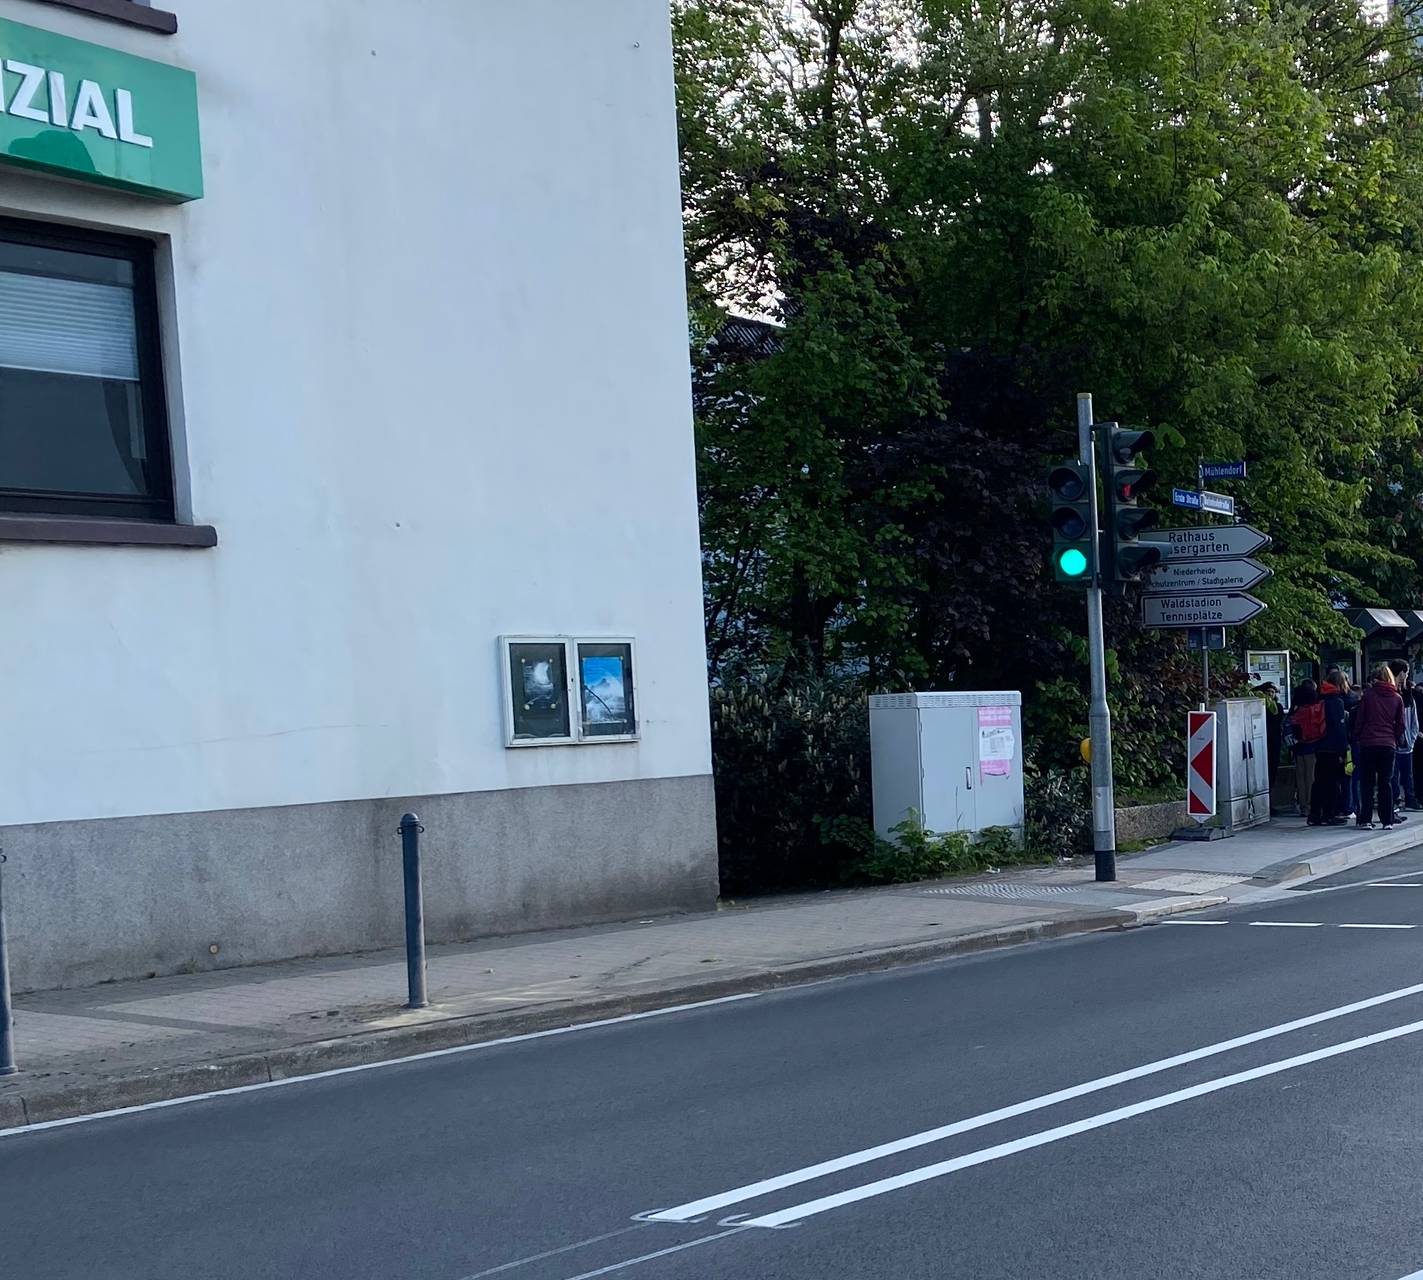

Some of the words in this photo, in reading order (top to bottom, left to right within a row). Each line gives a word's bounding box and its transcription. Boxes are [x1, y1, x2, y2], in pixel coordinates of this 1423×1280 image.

[1204, 465, 1242, 477] Mühlendorf
[1168, 531, 1215, 543] Rathaus
[1173, 567, 1216, 576] Niederheide
[1201, 576, 1244, 586] Stadtgalerie
[1160, 598, 1222, 609] Waldstadion
[1160, 609, 1223, 622] Tennisplätze
